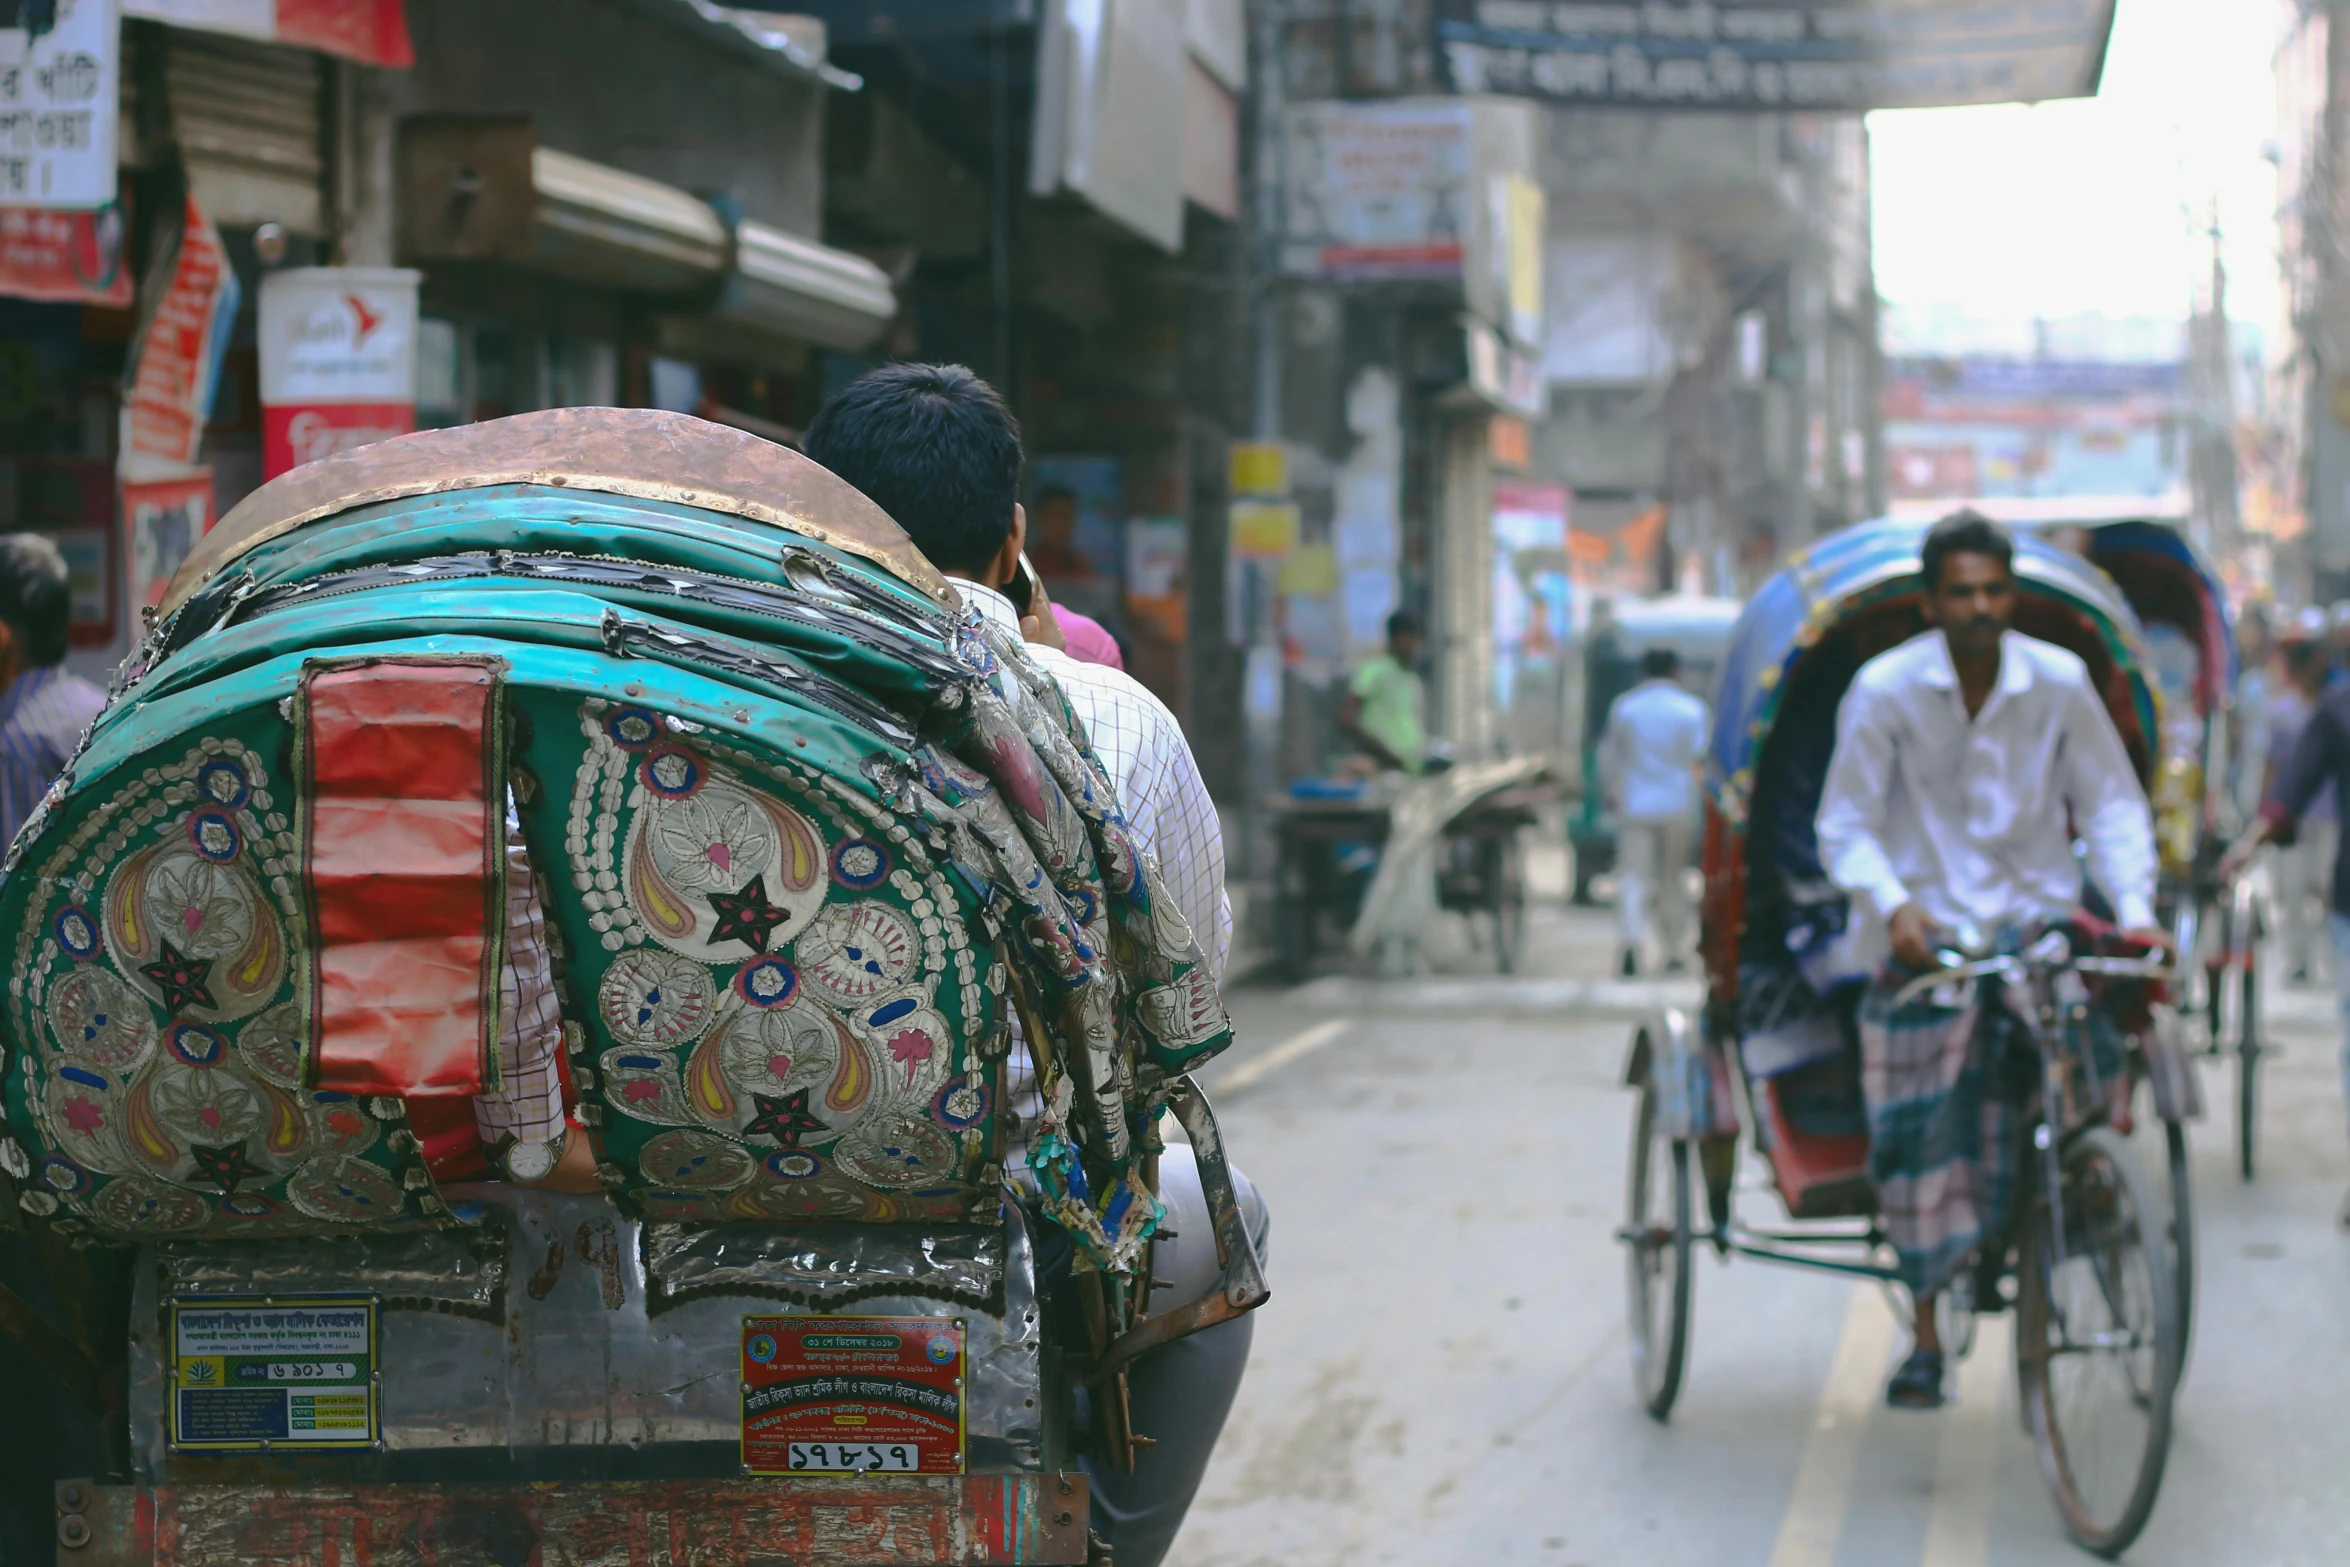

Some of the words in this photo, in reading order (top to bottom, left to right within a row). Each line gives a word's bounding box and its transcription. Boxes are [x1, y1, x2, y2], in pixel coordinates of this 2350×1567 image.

[822, 1338, 833, 1346] শে
[836, 1336, 867, 1346] ডিসেম্বর
[870, 1338, 894, 1347] ২০১৮
[746, 1391, 770, 1409] জাতীয়
[793, 1384, 810, 1398] ভ্যান
[812, 1378, 832, 1396] শ্রমিক
[834, 1377, 848, 1394] লীগ
[851, 1382, 858, 1393] ও
[860, 1381, 893, 1396] বাংলাদেশ
[919, 1389, 941, 1406] মালিক
[941, 1394, 958, 1414] লীগ
[792, 1444, 909, 1470] ১৭৮১৭
